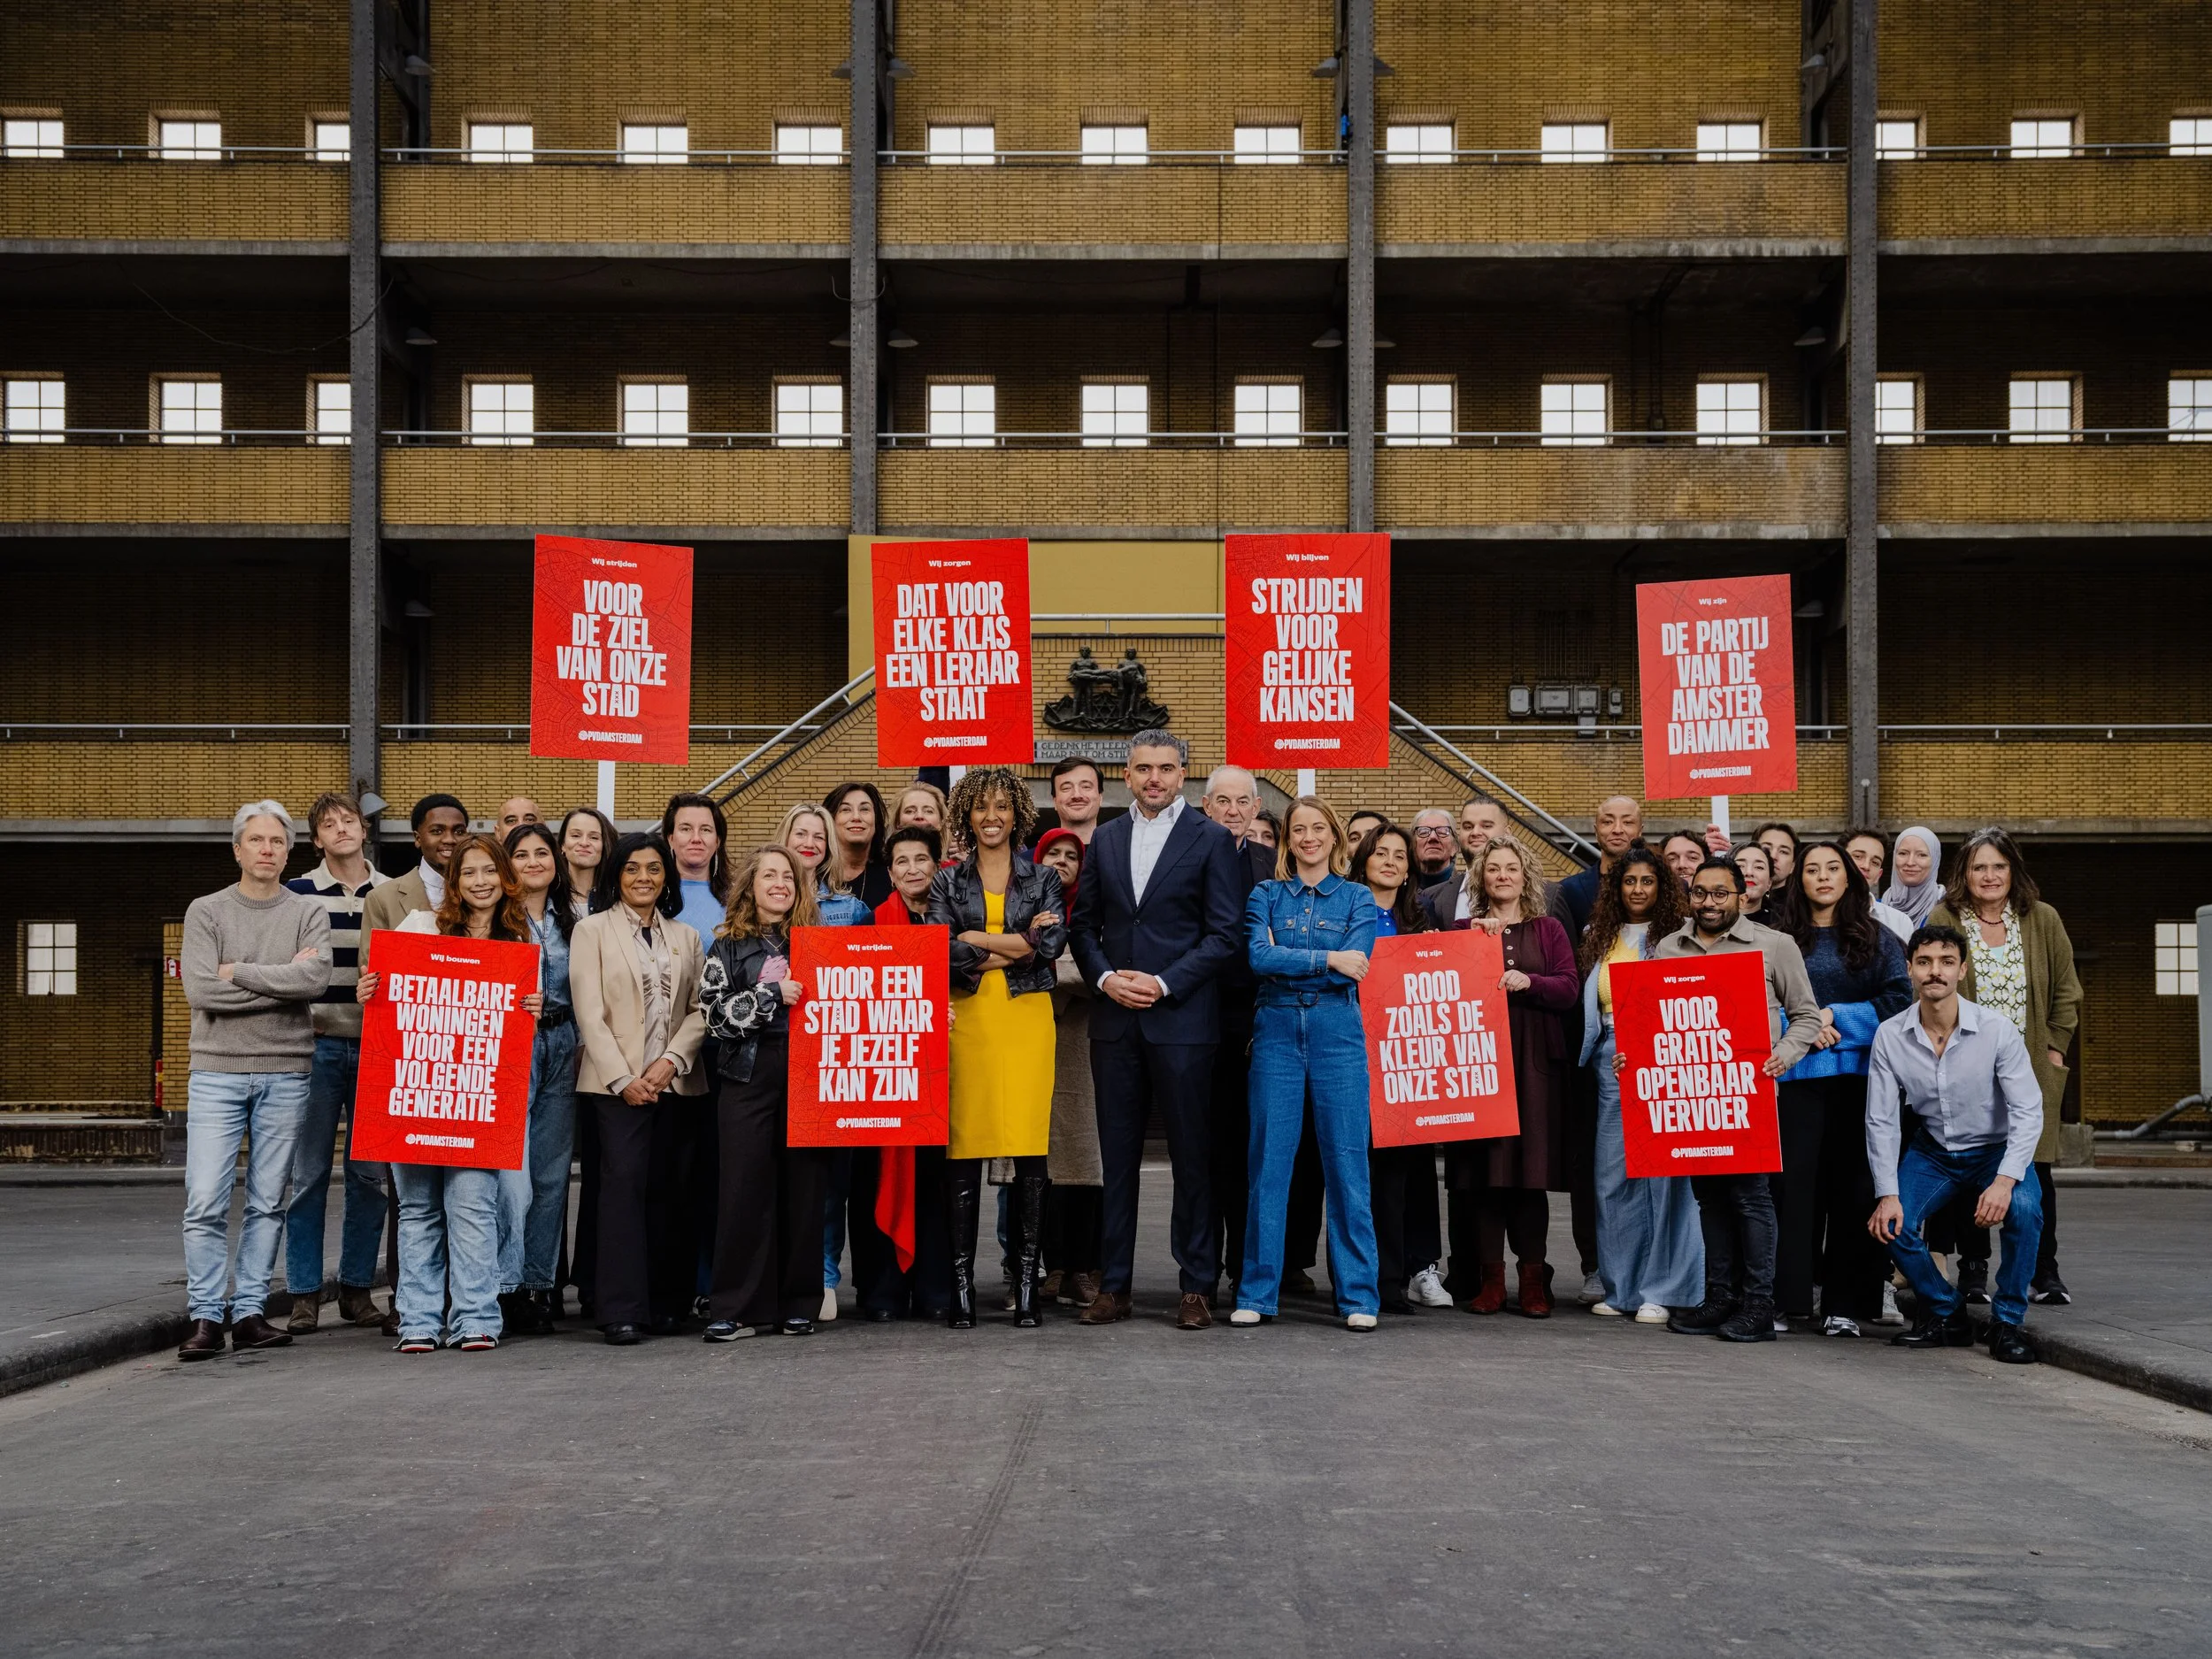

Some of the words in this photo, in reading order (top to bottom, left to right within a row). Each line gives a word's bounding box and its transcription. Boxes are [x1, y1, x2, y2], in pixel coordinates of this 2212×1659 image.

[591, 557, 605, 567] Wij
[605, 559, 638, 569] strijden
[1286, 553, 1300, 563] Wij
[1301, 553, 1330, 563] blijven
[584, 580, 643, 617] VOOR
[897, 583, 939, 618] DAT
[945, 581, 1005, 616] VOOR
[1252, 578, 1363, 614] STRIJDEN
[1698, 597, 1712, 607] Wij
[1712, 596, 1728, 606] zijn
[572, 613, 601, 647] DE
[606, 616, 653, 651] ZIEL
[894, 618, 948, 653] ELKE
[954, 616, 1010, 650] KLAS
[1276, 614, 1339, 649] VOOR
[1662, 622, 1690, 656] DE
[1696, 617, 1770, 654] PARTIJ
[557, 646, 603, 681] VAN
[609, 649, 667, 686] ONZE
[887, 653, 928, 687] EEN
[934, 650, 1020, 686] LERAAR
[1263, 650, 1352, 686] GELIJKE
[1676, 653, 1722, 687] VAN
[1728, 651, 1756, 685] DE
[583, 681, 640, 717] STAD
[920, 686, 988, 721] STAAT
[1260, 687, 1355, 722] KANSEN
[1672, 684, 1764, 722] AMSTER
[1041, 741, 1079, 750] GEDENK
[1080, 741, 1100, 750] HET
[1668, 717, 1770, 755] DAMMER
[1041, 750, 1067, 759] MAAR
[430, 953, 445, 964] Wij
[446, 955, 480, 964] bouwen
[847, 943, 861, 953] Wij
[861, 943, 893, 953] strijden
[1415, 950, 1429, 959] Wij
[1429, 949, 1443, 958] zijn
[388, 973, 517, 1011] BETAALBARE
[817, 966, 875, 1000] VOOR
[882, 966, 923, 999] EEN
[1403, 970, 1462, 1005] ROOD
[1663, 976, 1677, 985] Wij
[1678, 975, 1706, 984] zorgen
[397, 1002, 505, 1038] WONINGEN
[805, 1000, 861, 1033] STAD
[867, 1000, 934, 1033] WAAR
[1386, 1002, 1452, 1039] ZOALS
[1457, 1000, 1486, 1033] DE
[1659, 996, 1721, 1031] VOOR
[403, 1032, 456, 1063] VOOR
[462, 1036, 500, 1066] EEN
[818, 1034, 841, 1068] JE
[848, 1033, 920, 1067] JEZELF
[1379, 1036, 1448, 1071] KLEUR
[1453, 1032, 1498, 1065] VAN
[1654, 1029, 1732, 1065] GRATIS
[396, 1059, 497, 1094] VOLGENDE
[819, 1068, 866, 1102] KAN
[872, 1068, 918, 1102] ZIJN
[1384, 1069, 1440, 1104] ONZE
[1445, 1064, 1499, 1099] STAD
[1637, 1062, 1758, 1100] OPENBAAR
[388, 1087, 497, 1122] GENERATIE
[1648, 1096, 1751, 1133] VERVOER
